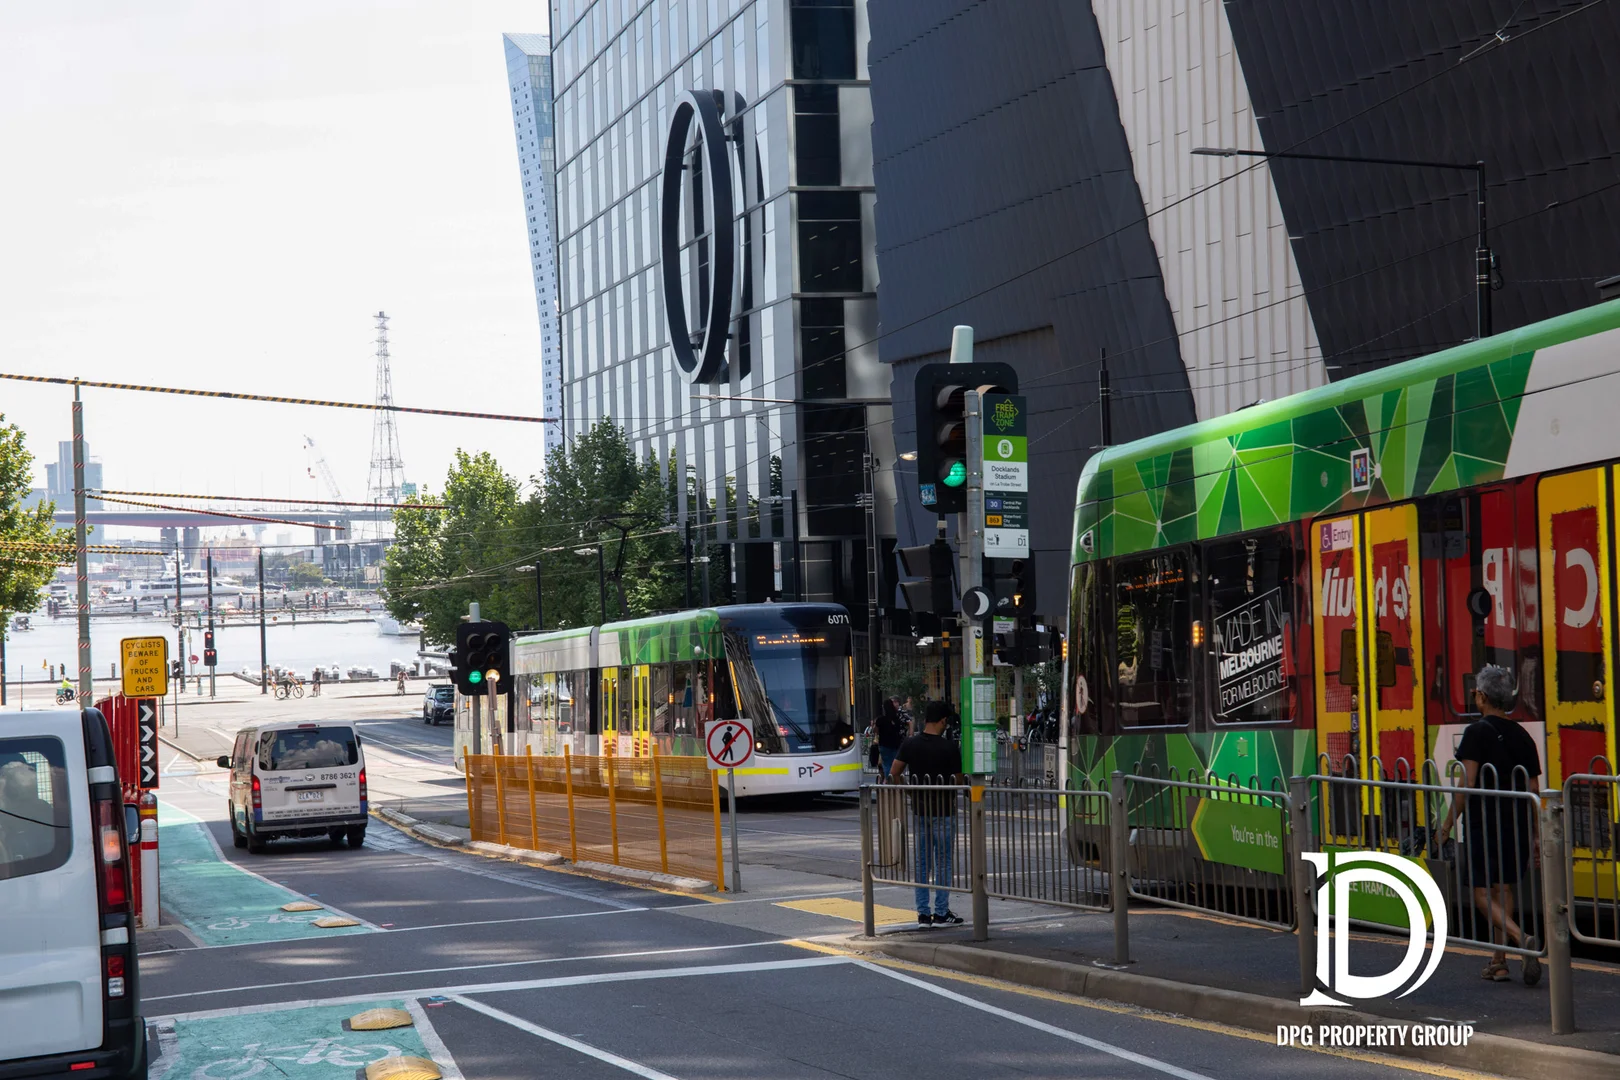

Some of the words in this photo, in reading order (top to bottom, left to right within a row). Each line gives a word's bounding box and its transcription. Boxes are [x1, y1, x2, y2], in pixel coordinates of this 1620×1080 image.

[1018, 538, 1026, 546] D1
[1333, 528, 1352, 542] Entry
[828, 615, 849, 624] 6071
[1216, 604, 1263, 657] MADE
[1265, 595, 1281, 634] IN
[1220, 634, 1283, 680] MELBOURNE
[1222, 686, 1238, 707] FOR
[1238, 665, 1285, 700] MELBOURNE
[1230, 824, 1254, 844] You're
[1255, 828, 1263, 846] in
[1265, 831, 1278, 848] the
